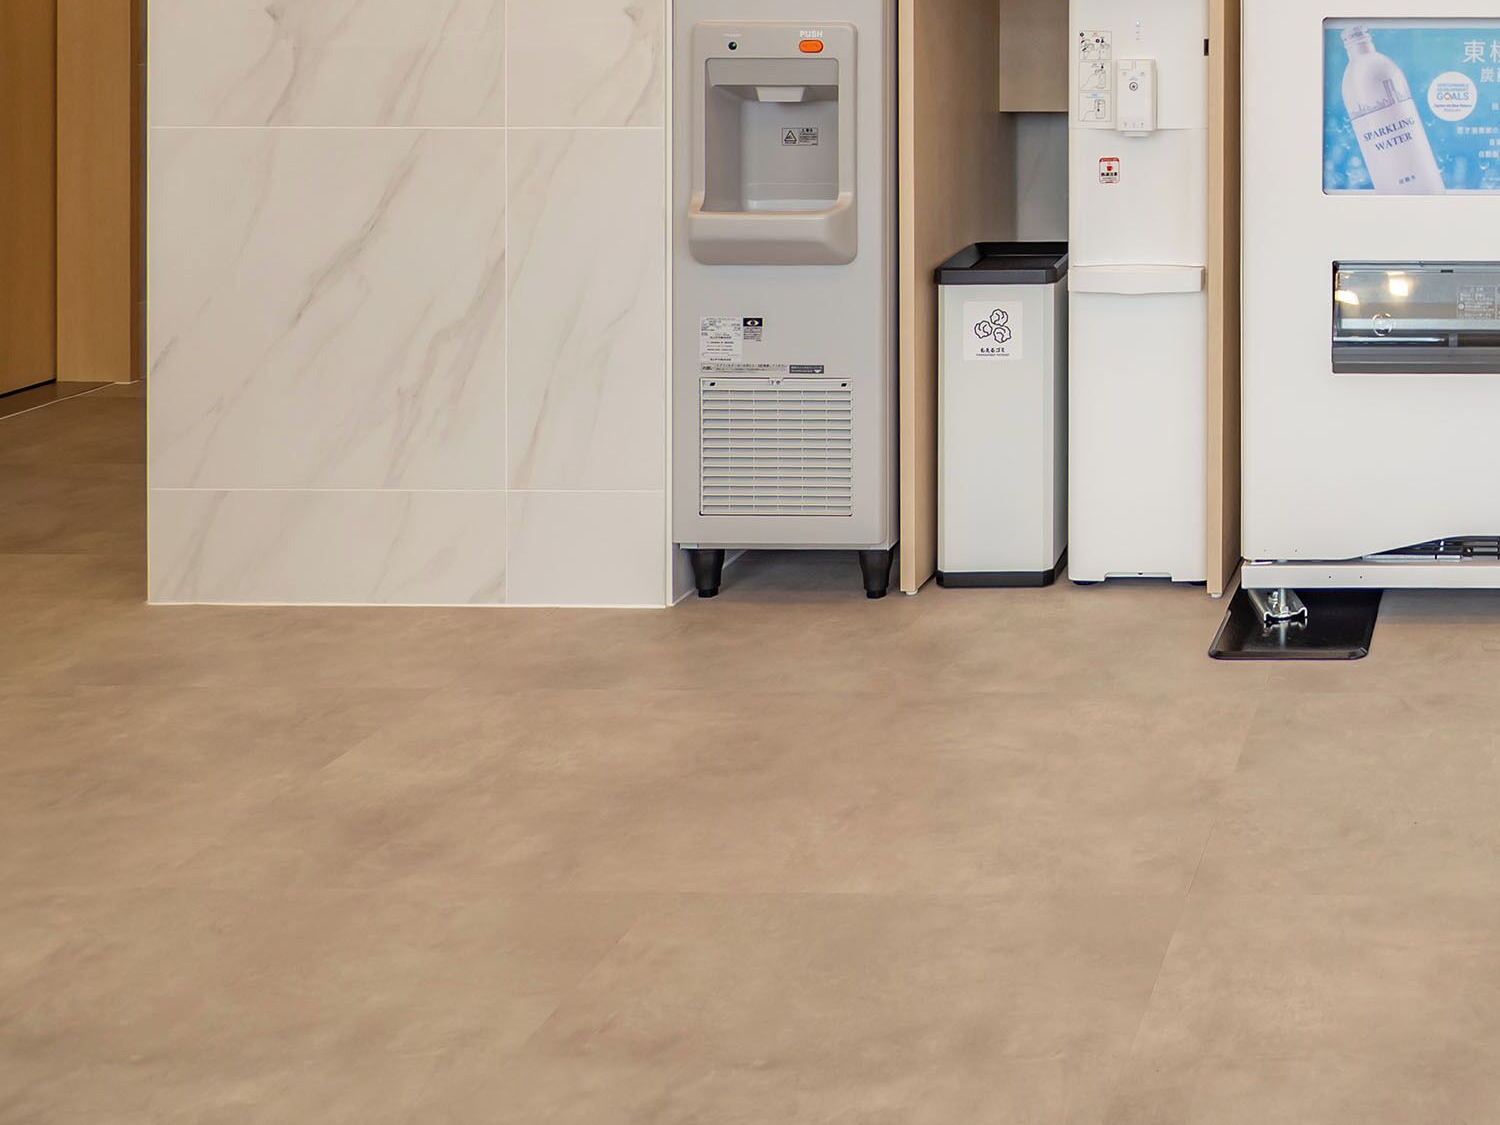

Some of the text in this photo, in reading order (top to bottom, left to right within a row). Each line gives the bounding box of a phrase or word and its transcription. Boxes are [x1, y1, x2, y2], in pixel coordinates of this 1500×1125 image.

[799, 30, 823, 38] PUSH
[1436, 92, 1470, 101] GOALS
[1363, 116, 1415, 142] SPARKLING
[1374, 132, 1413, 152] WATER
